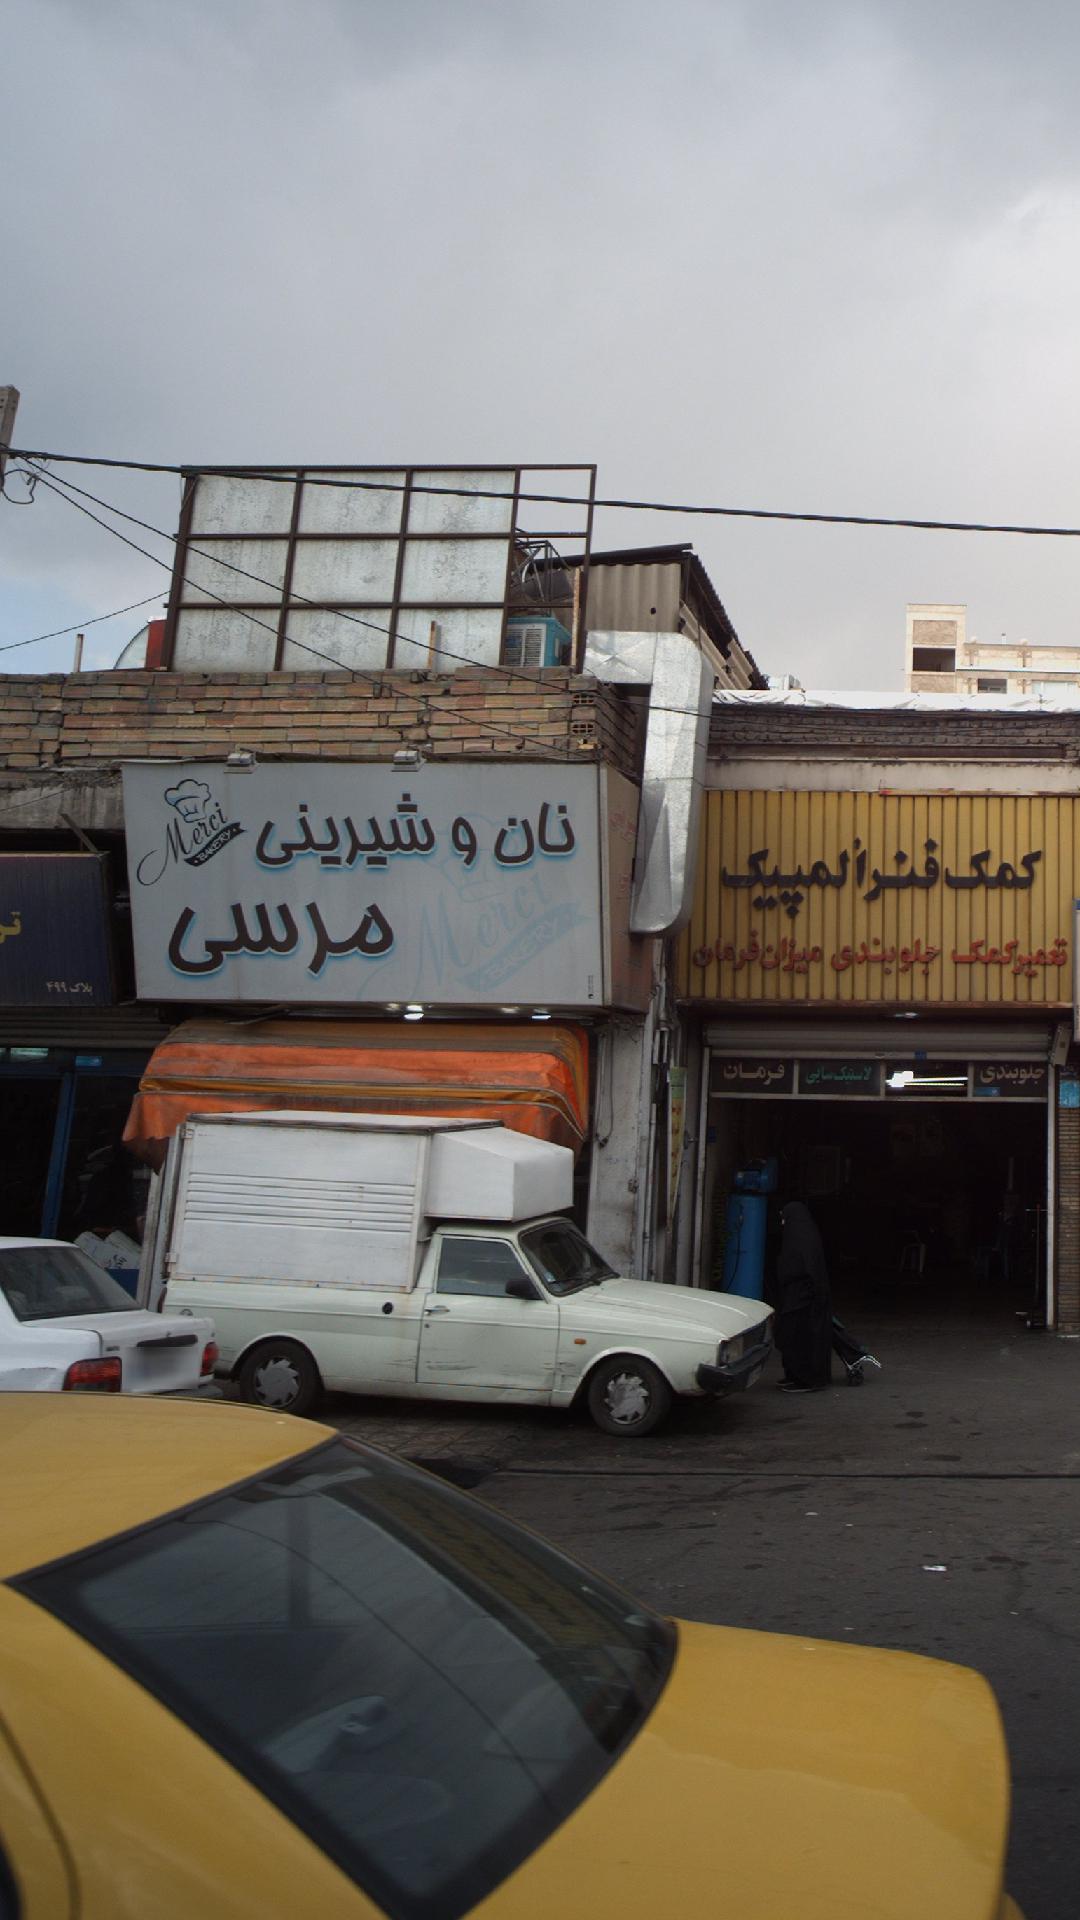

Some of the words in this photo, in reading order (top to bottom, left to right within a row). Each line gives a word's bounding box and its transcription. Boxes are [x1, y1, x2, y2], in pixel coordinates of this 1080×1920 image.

[136, 801, 228, 886] Merci
[256, 793, 435, 866] شیرینی
[452, 816, 477, 866] و
[494, 802, 575, 865] نان
[864, 838, 940, 901] فنر
[945, 850, 1043, 889] کمک
[168, 901, 394, 976] مرسی
[693, 929, 760, 971] فرمان
[760, 936, 822, 975] میزان
[951, 938, 1019, 965] کمک
[1011, 937, 1068, 978] تعمیر
[723, 1061, 785, 1085] فرمان
